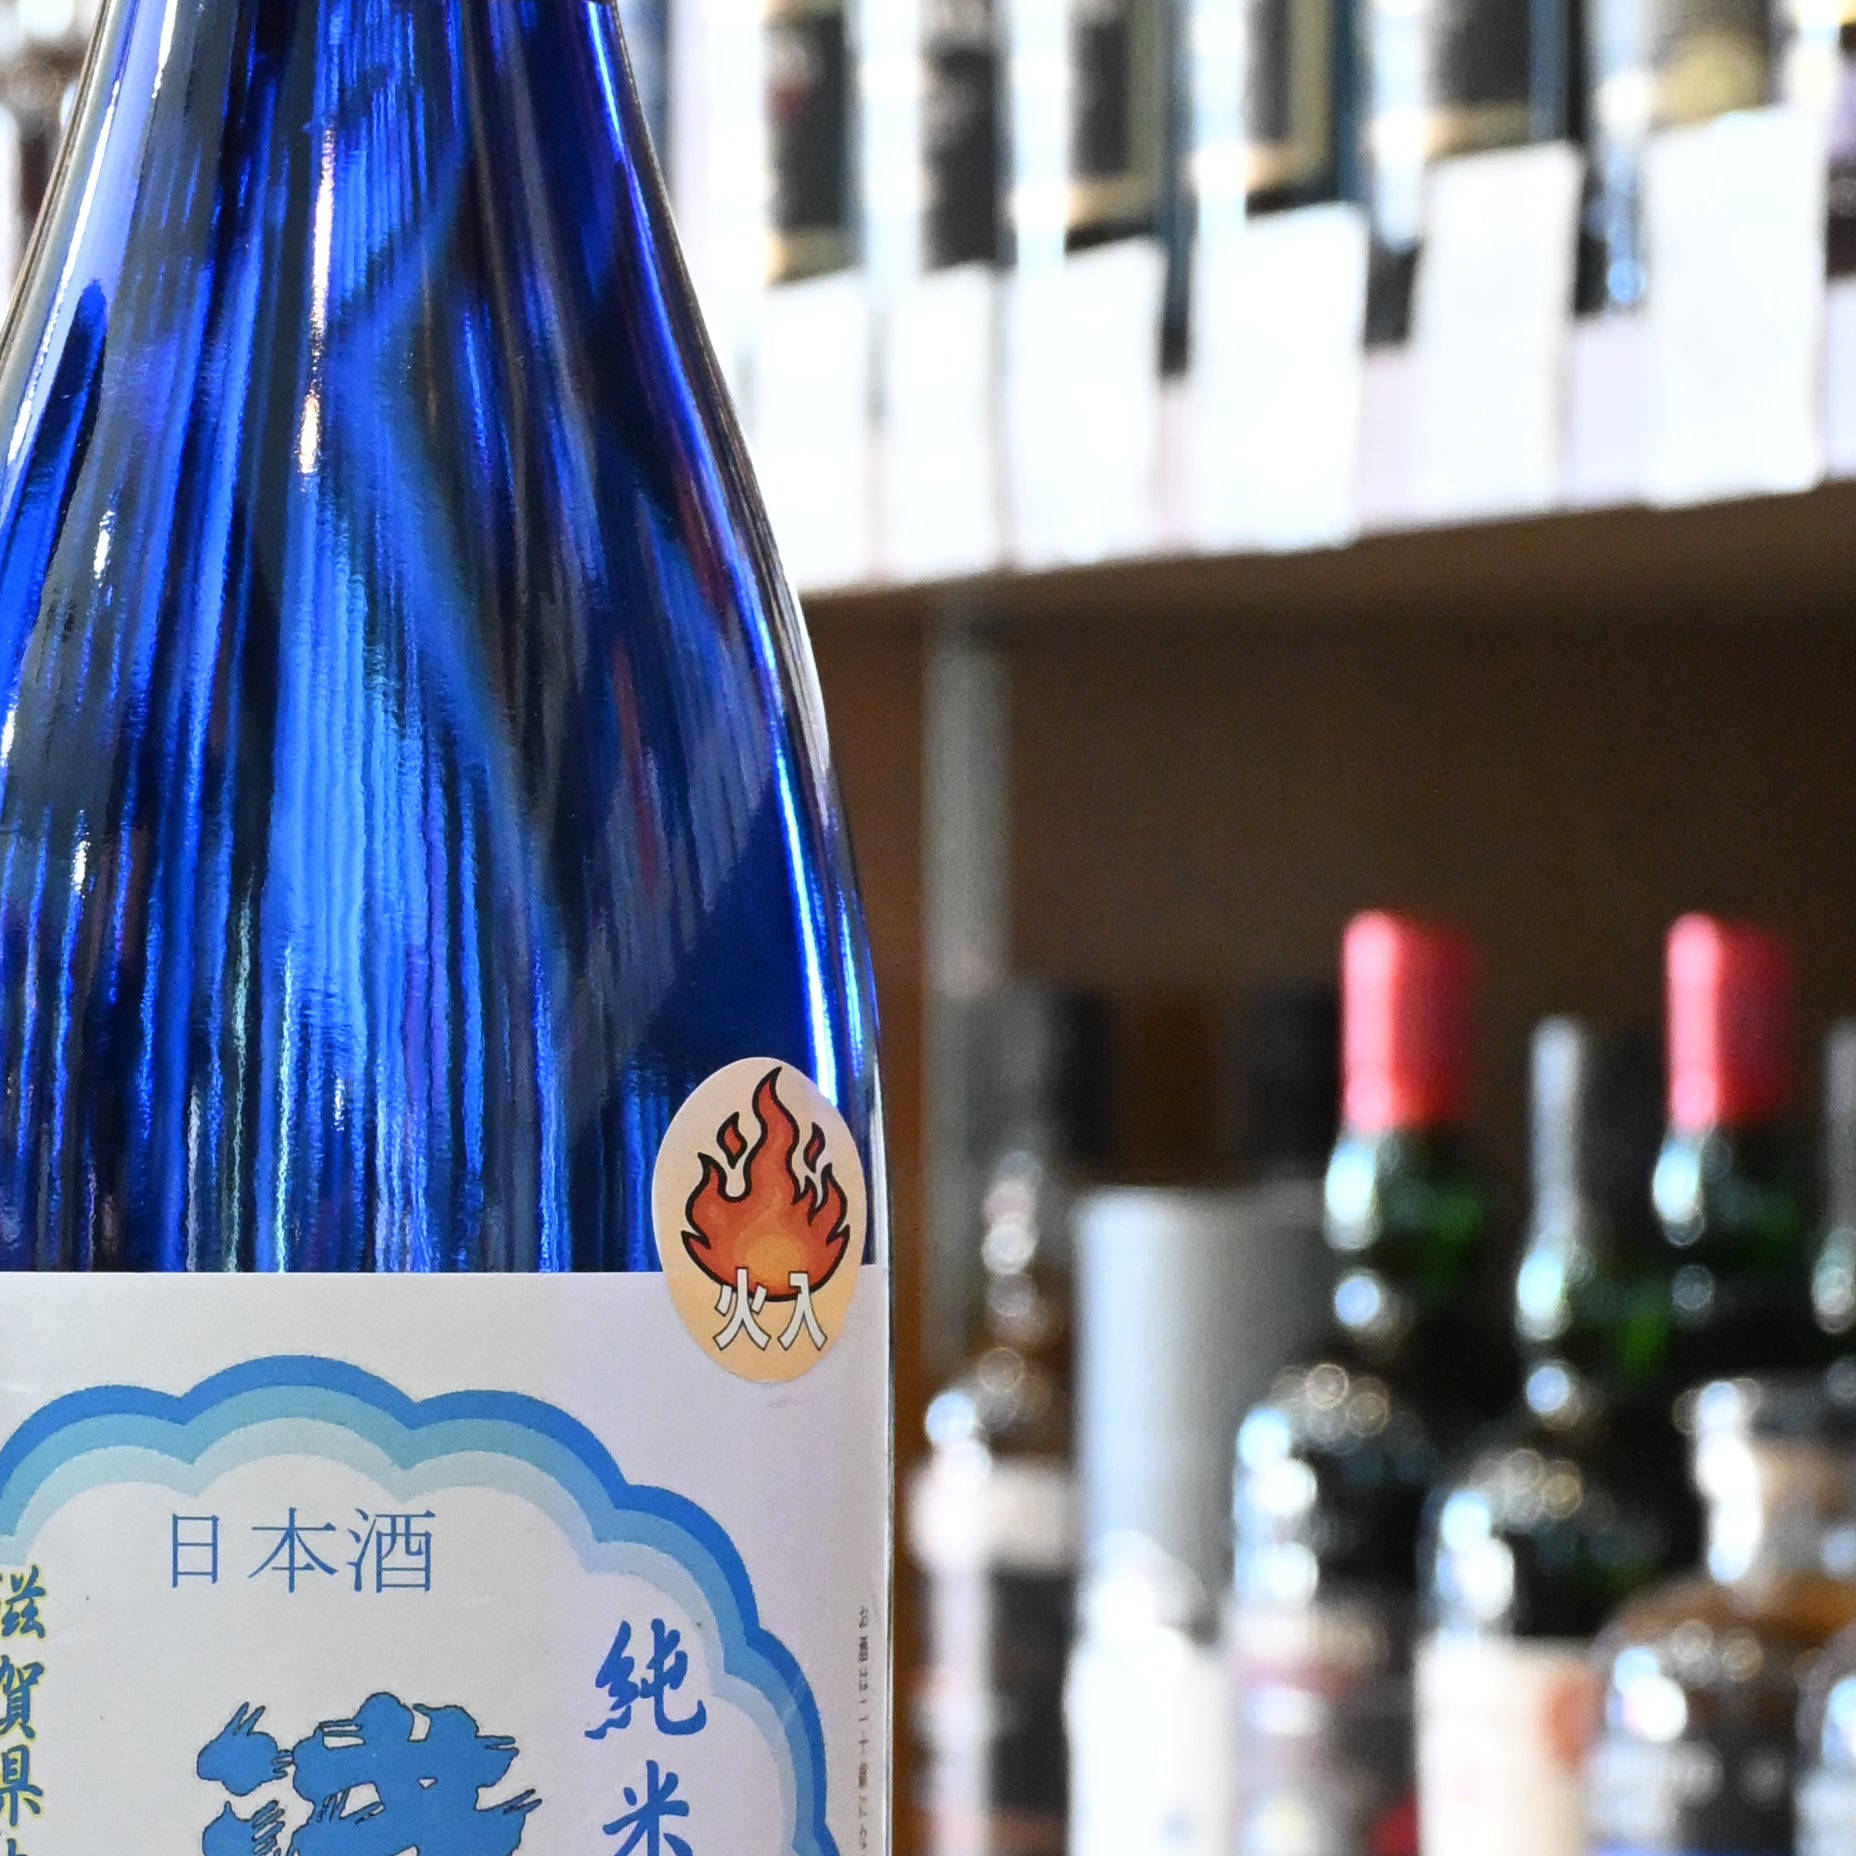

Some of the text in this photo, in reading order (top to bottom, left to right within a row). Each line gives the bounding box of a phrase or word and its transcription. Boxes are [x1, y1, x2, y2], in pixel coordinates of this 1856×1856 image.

[713, 1267, 828, 1351] 火入
[171, 1506, 436, 1594] 日本酒
